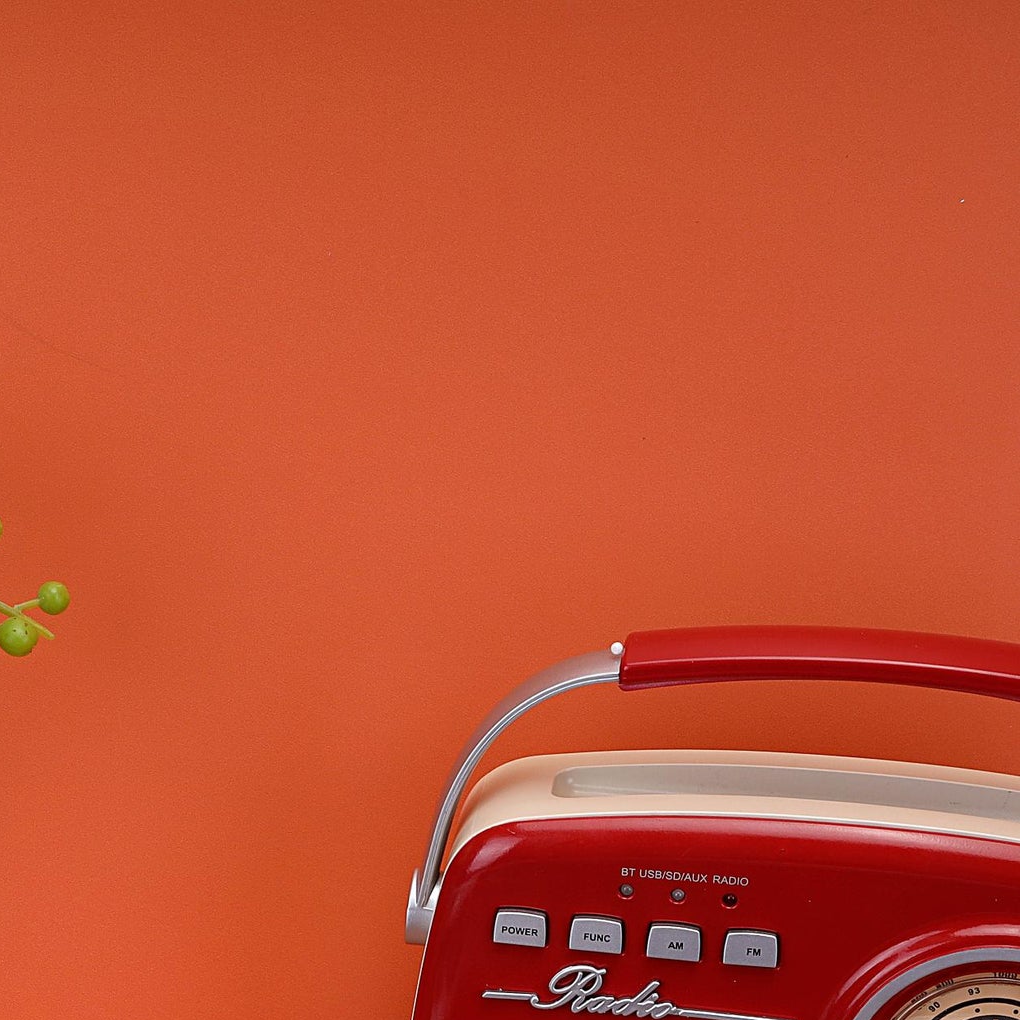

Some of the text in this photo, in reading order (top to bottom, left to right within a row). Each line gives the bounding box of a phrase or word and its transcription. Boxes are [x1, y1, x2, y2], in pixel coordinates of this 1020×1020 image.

[621, 867, 749, 886] BT USB/SD/AUX RADIO
[501, 926, 538, 938] POWER
[583, 933, 611, 943] FUNC
[668, 941, 684, 950] AM
[747, 948, 761, 956] FM
[531, 965, 682, 1020] Radio
[968, 987, 980, 996] 93
[928, 1001, 941, 1012] 90
